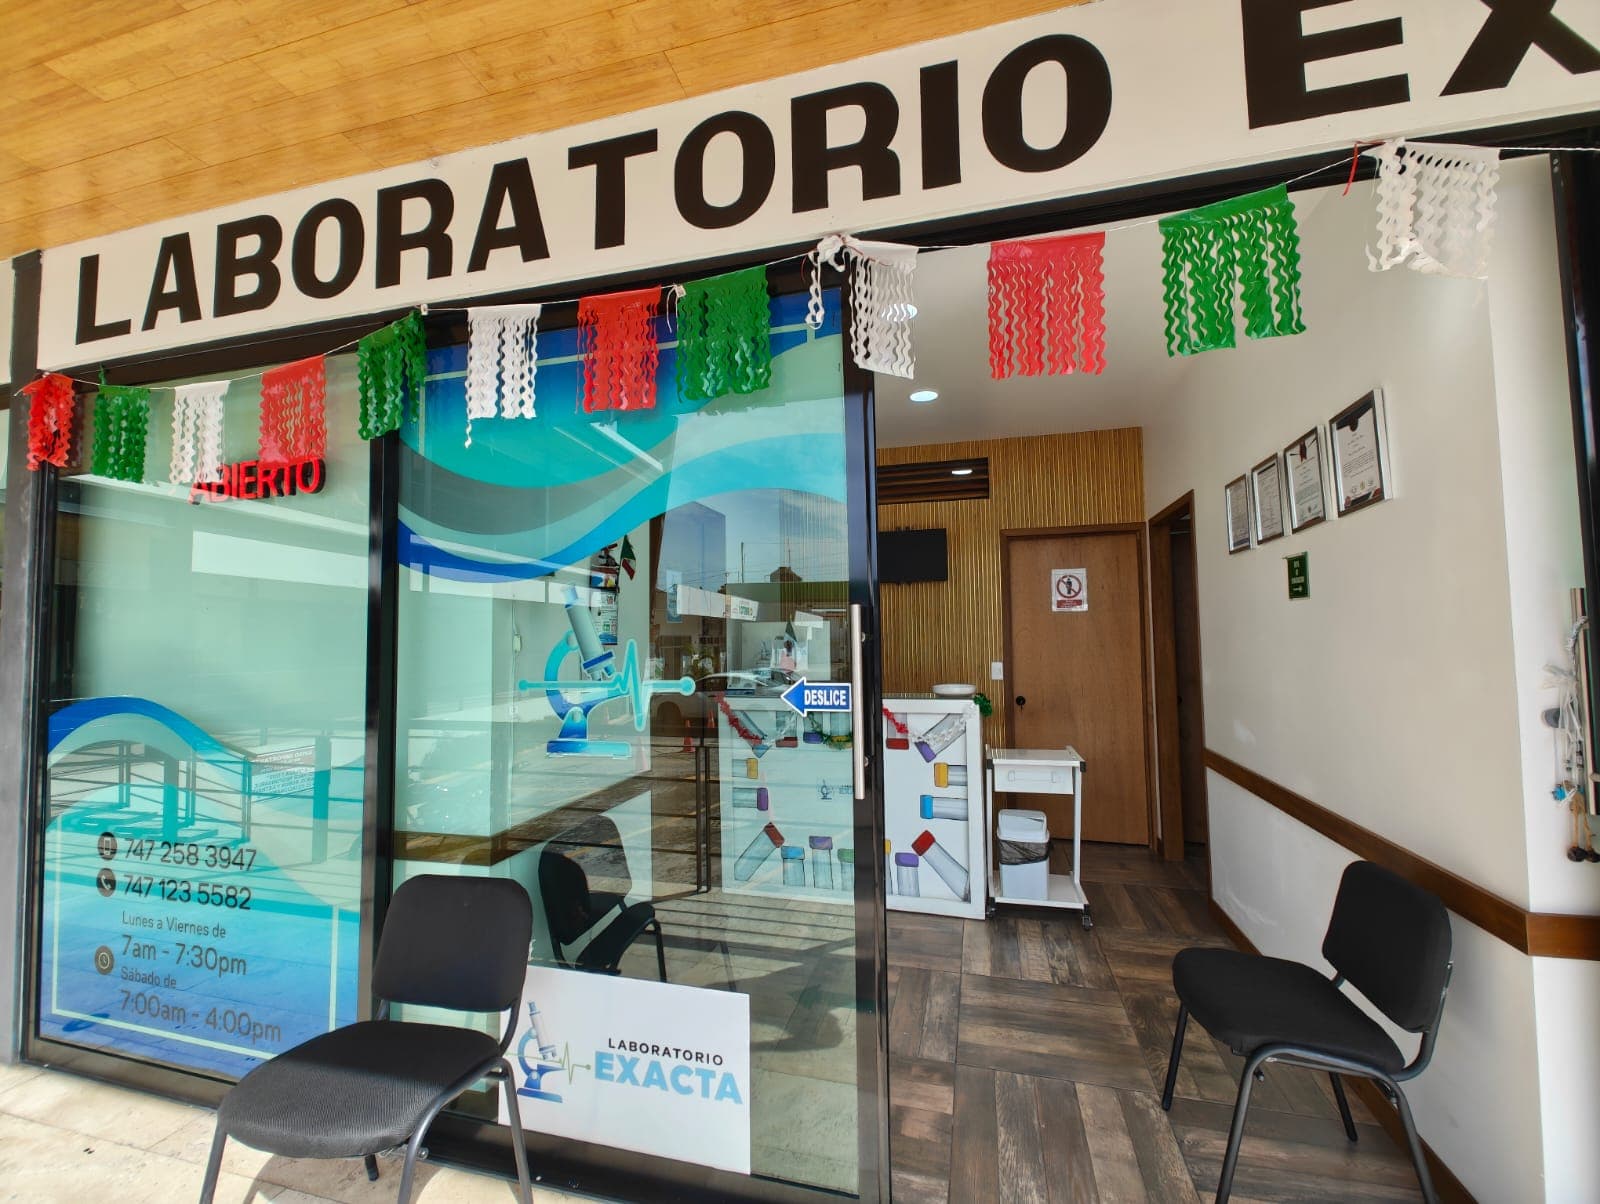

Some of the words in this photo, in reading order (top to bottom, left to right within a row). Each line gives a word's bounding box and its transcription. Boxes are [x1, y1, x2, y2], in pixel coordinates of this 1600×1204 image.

[74, 34, 1113, 345] LABORATORIO
[804, 689, 847, 706] DESLICE
[124, 838, 155, 862] 747
[160, 841, 199, 866] 258
[204, 845, 257, 872] 3947
[123, 874, 154, 897] 747
[158, 879, 191, 903] 123
[197, 884, 252, 910] 5582
[122, 911, 154, 929] Lunes
[156, 920, 163, 930] a
[166, 917, 209, 937] Viernes
[212, 924, 226, 938] de
[121, 934, 157, 961] 7am
[175, 943, 247, 977] 7:30pm
[120, 966, 161, 987] Sábado
[163, 975, 177, 989] de
[119, 990, 186, 1024] 7:00am
[204, 1007, 282, 1043] 4:00pm
[608, 1037, 724, 1066] LABORATORIO
[594, 1050, 744, 1105] EXACTA
